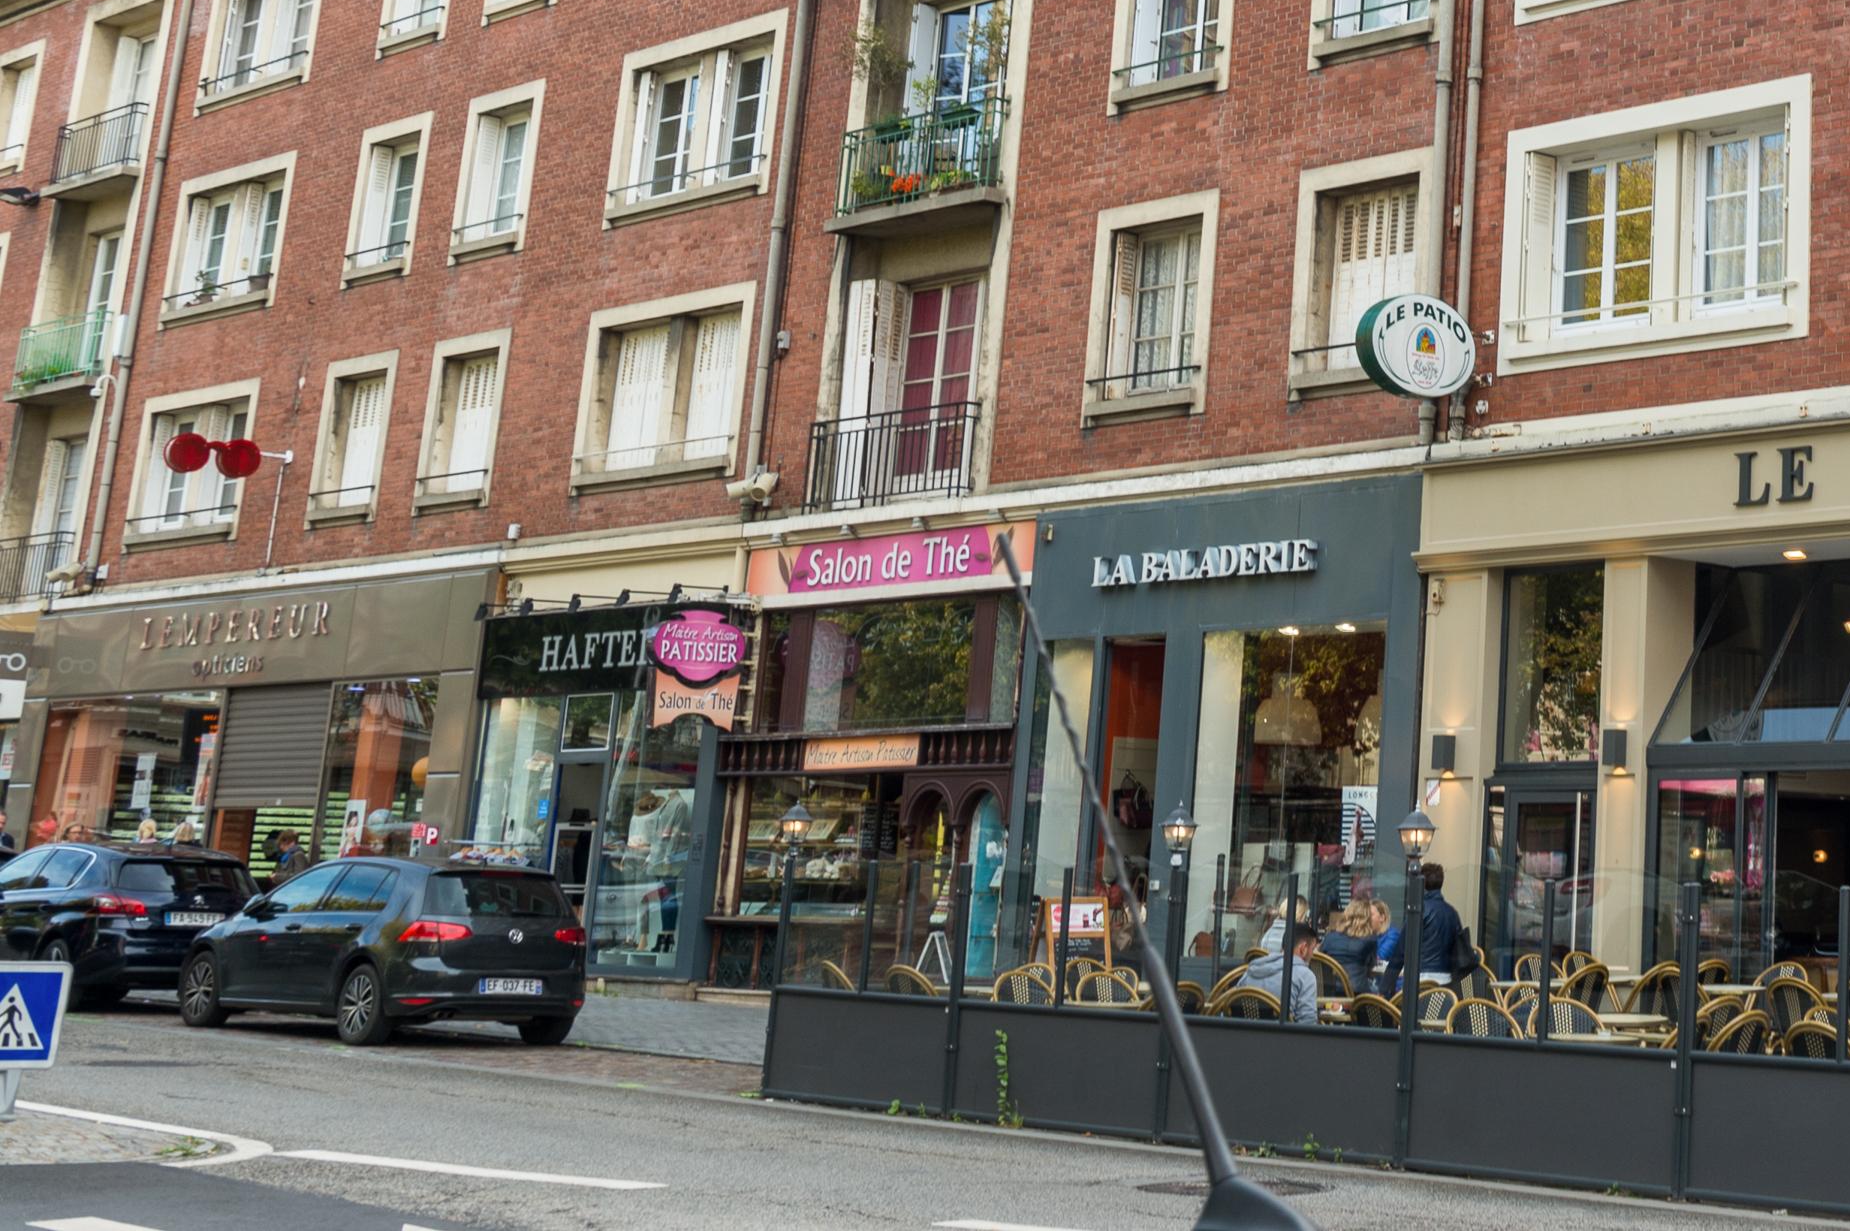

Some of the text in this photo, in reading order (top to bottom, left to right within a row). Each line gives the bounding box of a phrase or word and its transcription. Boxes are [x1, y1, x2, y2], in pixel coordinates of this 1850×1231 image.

[1386, 302, 1466, 344] LE PATIO
[1733, 445, 1814, 507] LE
[807, 534, 970, 586] Salon de Thé
[1092, 539, 1318, 587] LA BALADERIE
[139, 600, 329, 650] LEMPEREUR
[702, 625, 738, 642] Artisan
[192, 654, 264, 681] opticiens
[660, 640, 738, 663] PATISSIER
[659, 691, 692, 708] Salon
[711, 693, 733, 710] Thé
